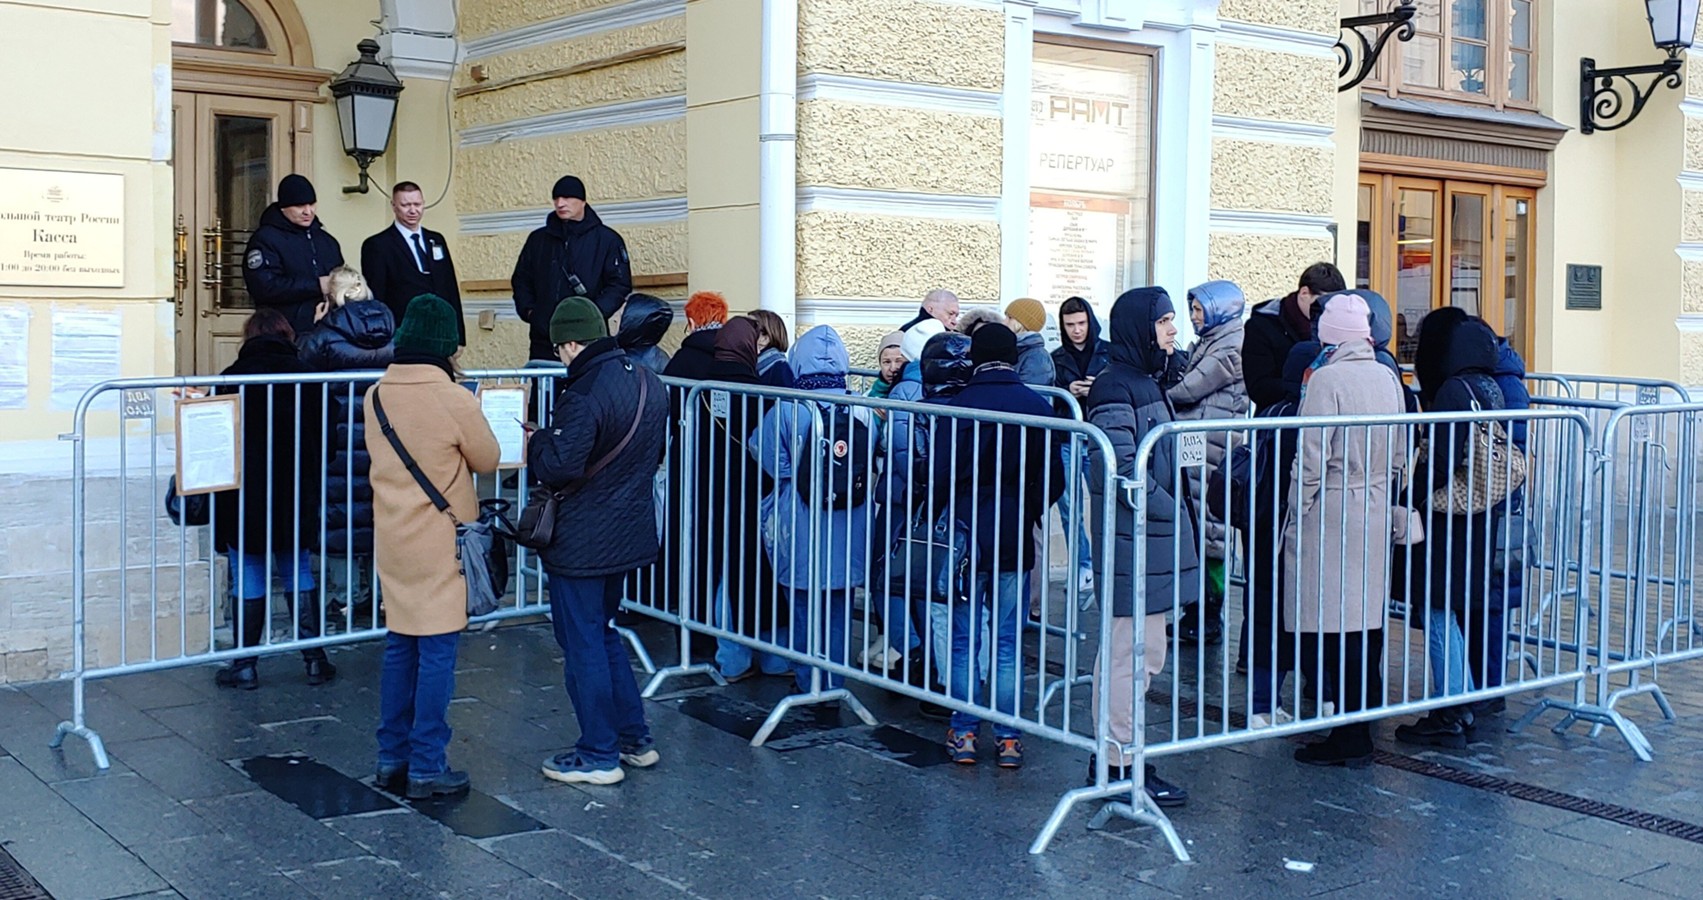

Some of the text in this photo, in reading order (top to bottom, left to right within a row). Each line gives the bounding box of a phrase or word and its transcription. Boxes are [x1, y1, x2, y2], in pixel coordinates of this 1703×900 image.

[1049, 95, 1129, 126] РАМТ
[1040, 152, 1114, 173] РЕПЕРТУАР
[44, 214, 77, 225] театр
[81, 212, 120, 224] России
[33, 228, 78, 243] Касса
[23, 250, 51, 260] Время
[34, 263, 60, 272] 20:00
[62, 264, 76, 273] без
[79, 266, 121, 274] выходных
